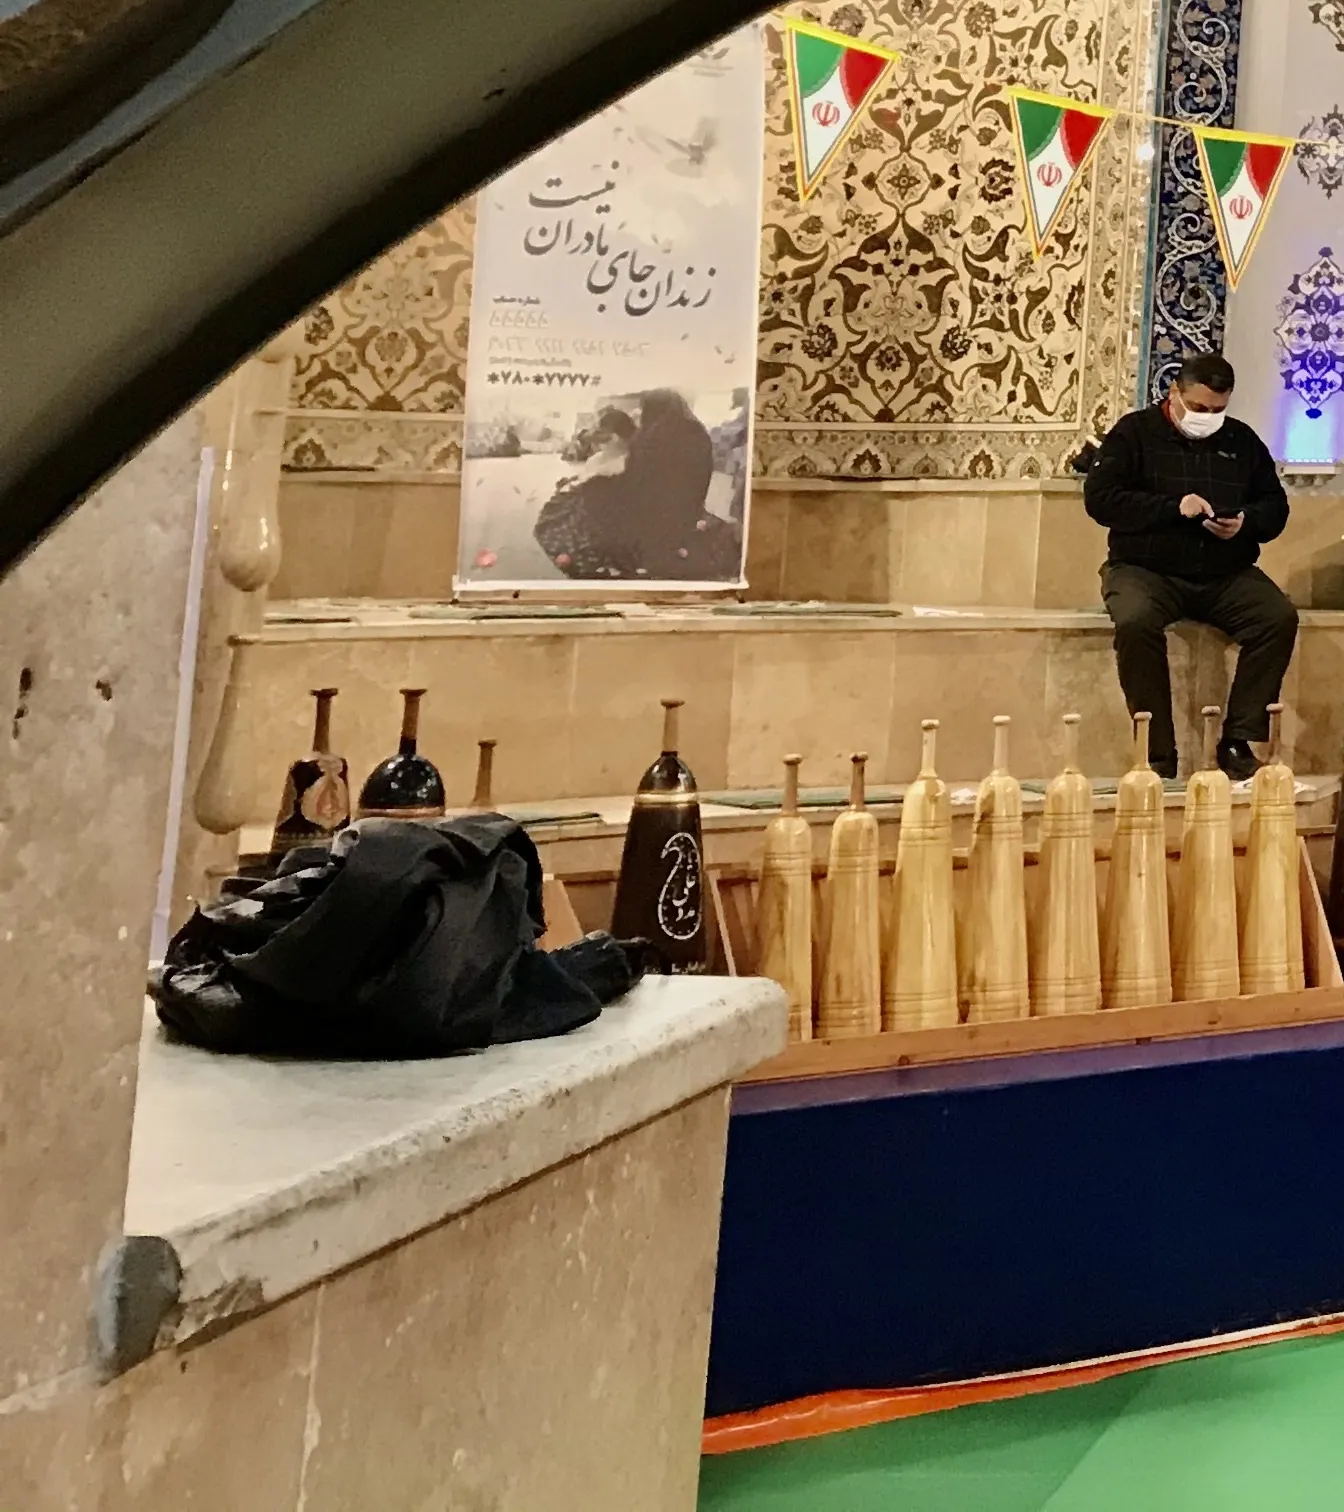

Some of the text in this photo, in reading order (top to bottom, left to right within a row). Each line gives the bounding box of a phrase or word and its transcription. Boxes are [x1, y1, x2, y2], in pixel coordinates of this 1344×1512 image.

[523, 160, 717, 317] زندان جای مادران نیست
